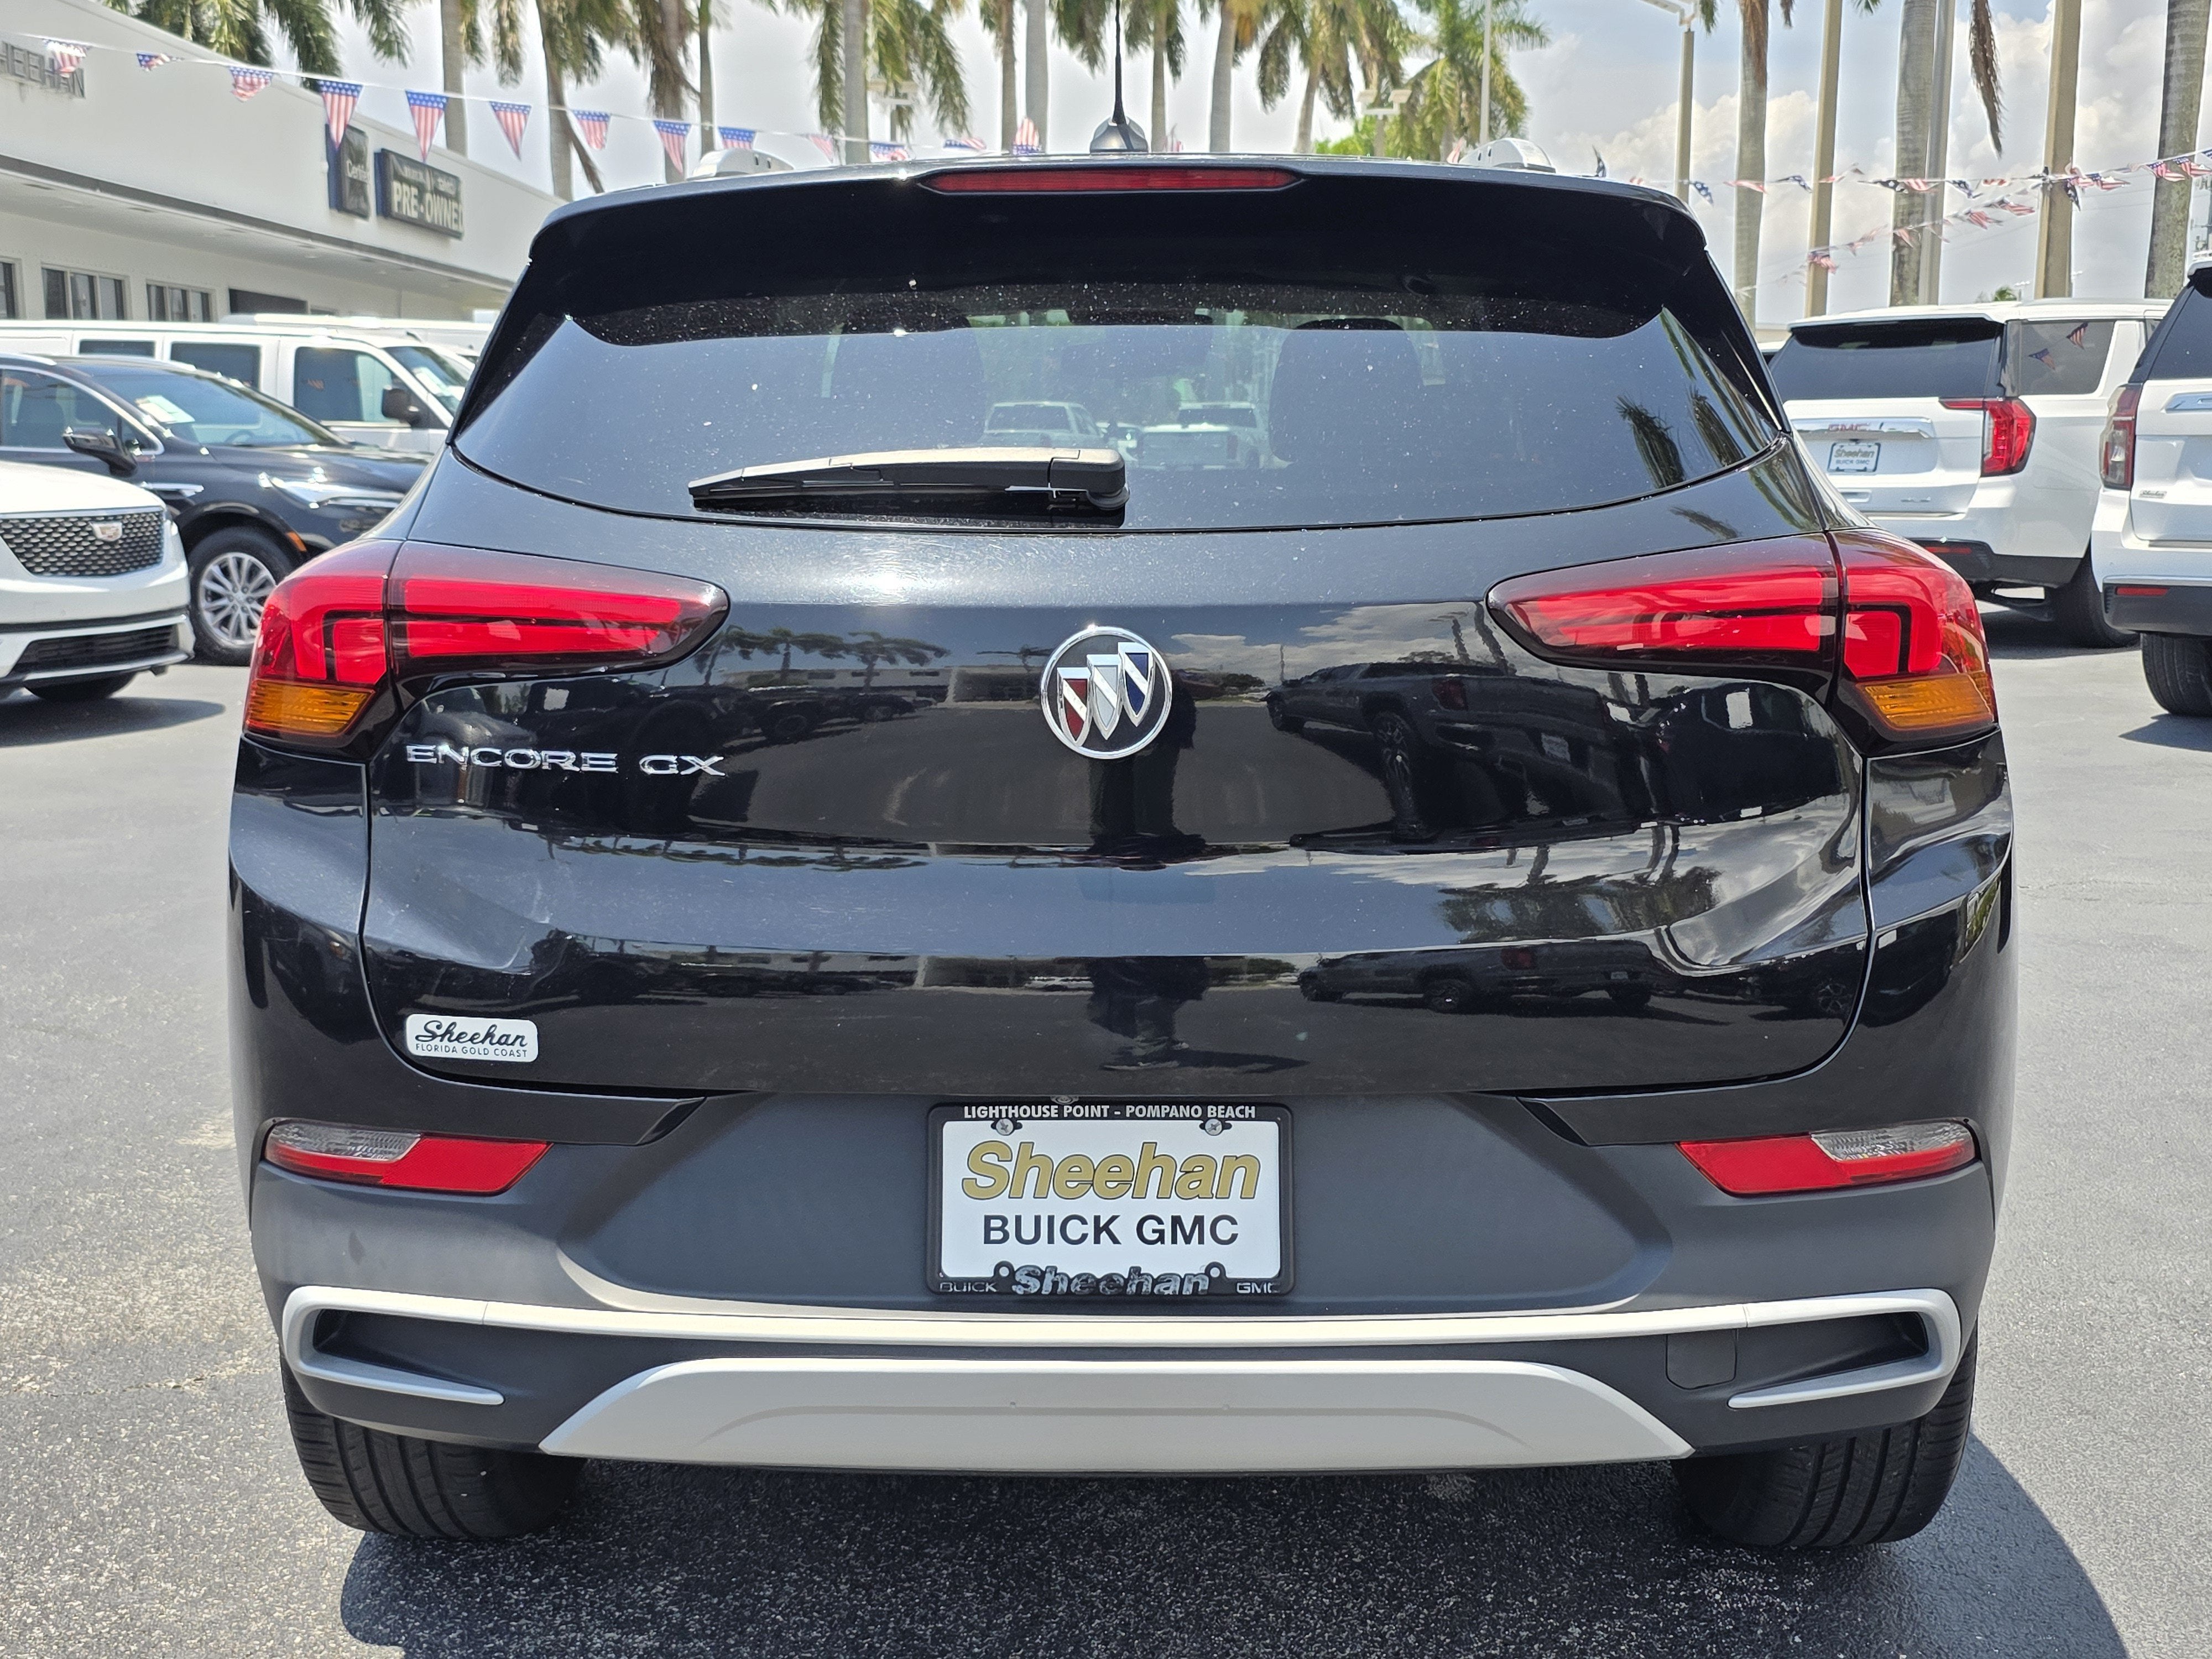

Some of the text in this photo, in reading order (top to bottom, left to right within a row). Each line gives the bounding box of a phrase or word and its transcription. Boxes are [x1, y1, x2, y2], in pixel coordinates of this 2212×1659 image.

[406, 744, 726, 776] ENCORE GX
[415, 1020, 528, 1047] Sheehan
[416, 1043, 527, 1057] FLORIDA GOLD COAST
[964, 1105, 1058, 1118] LIGHTHOUSE
[1063, 1105, 1109, 1118] POINT
[1125, 1105, 1202, 1118] POMPANO
[1207, 1105, 1255, 1118] BEACH
[962, 1140, 1261, 1199] Sheehan
[983, 1214, 1239, 1245] BUICK GMC
[940, 1265, 1281, 1295] BUICK Sheehan GMC
